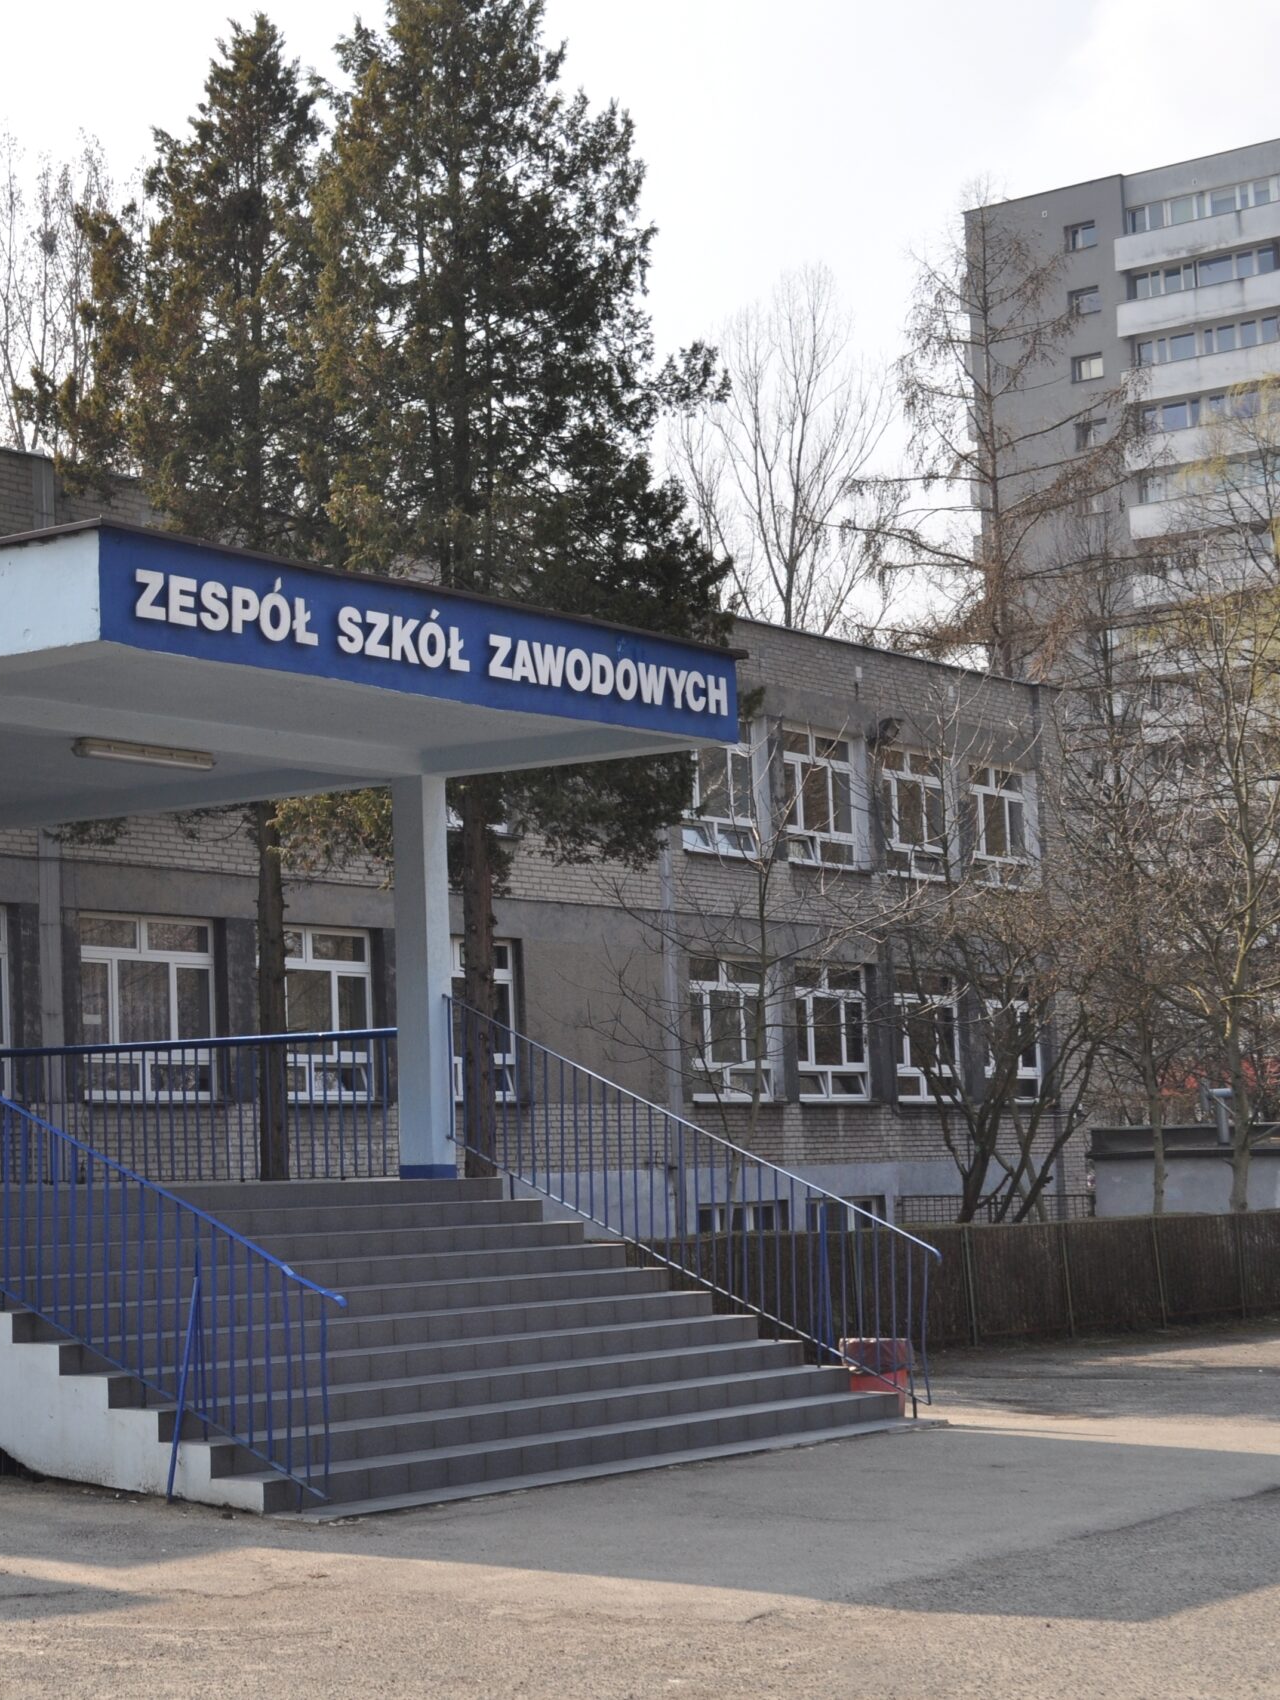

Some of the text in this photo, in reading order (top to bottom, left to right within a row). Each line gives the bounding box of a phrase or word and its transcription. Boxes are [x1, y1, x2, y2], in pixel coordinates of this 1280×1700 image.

[135, 568, 729, 717] ZESPÓŁ SZKÓŁ ZAWODOWYCH
